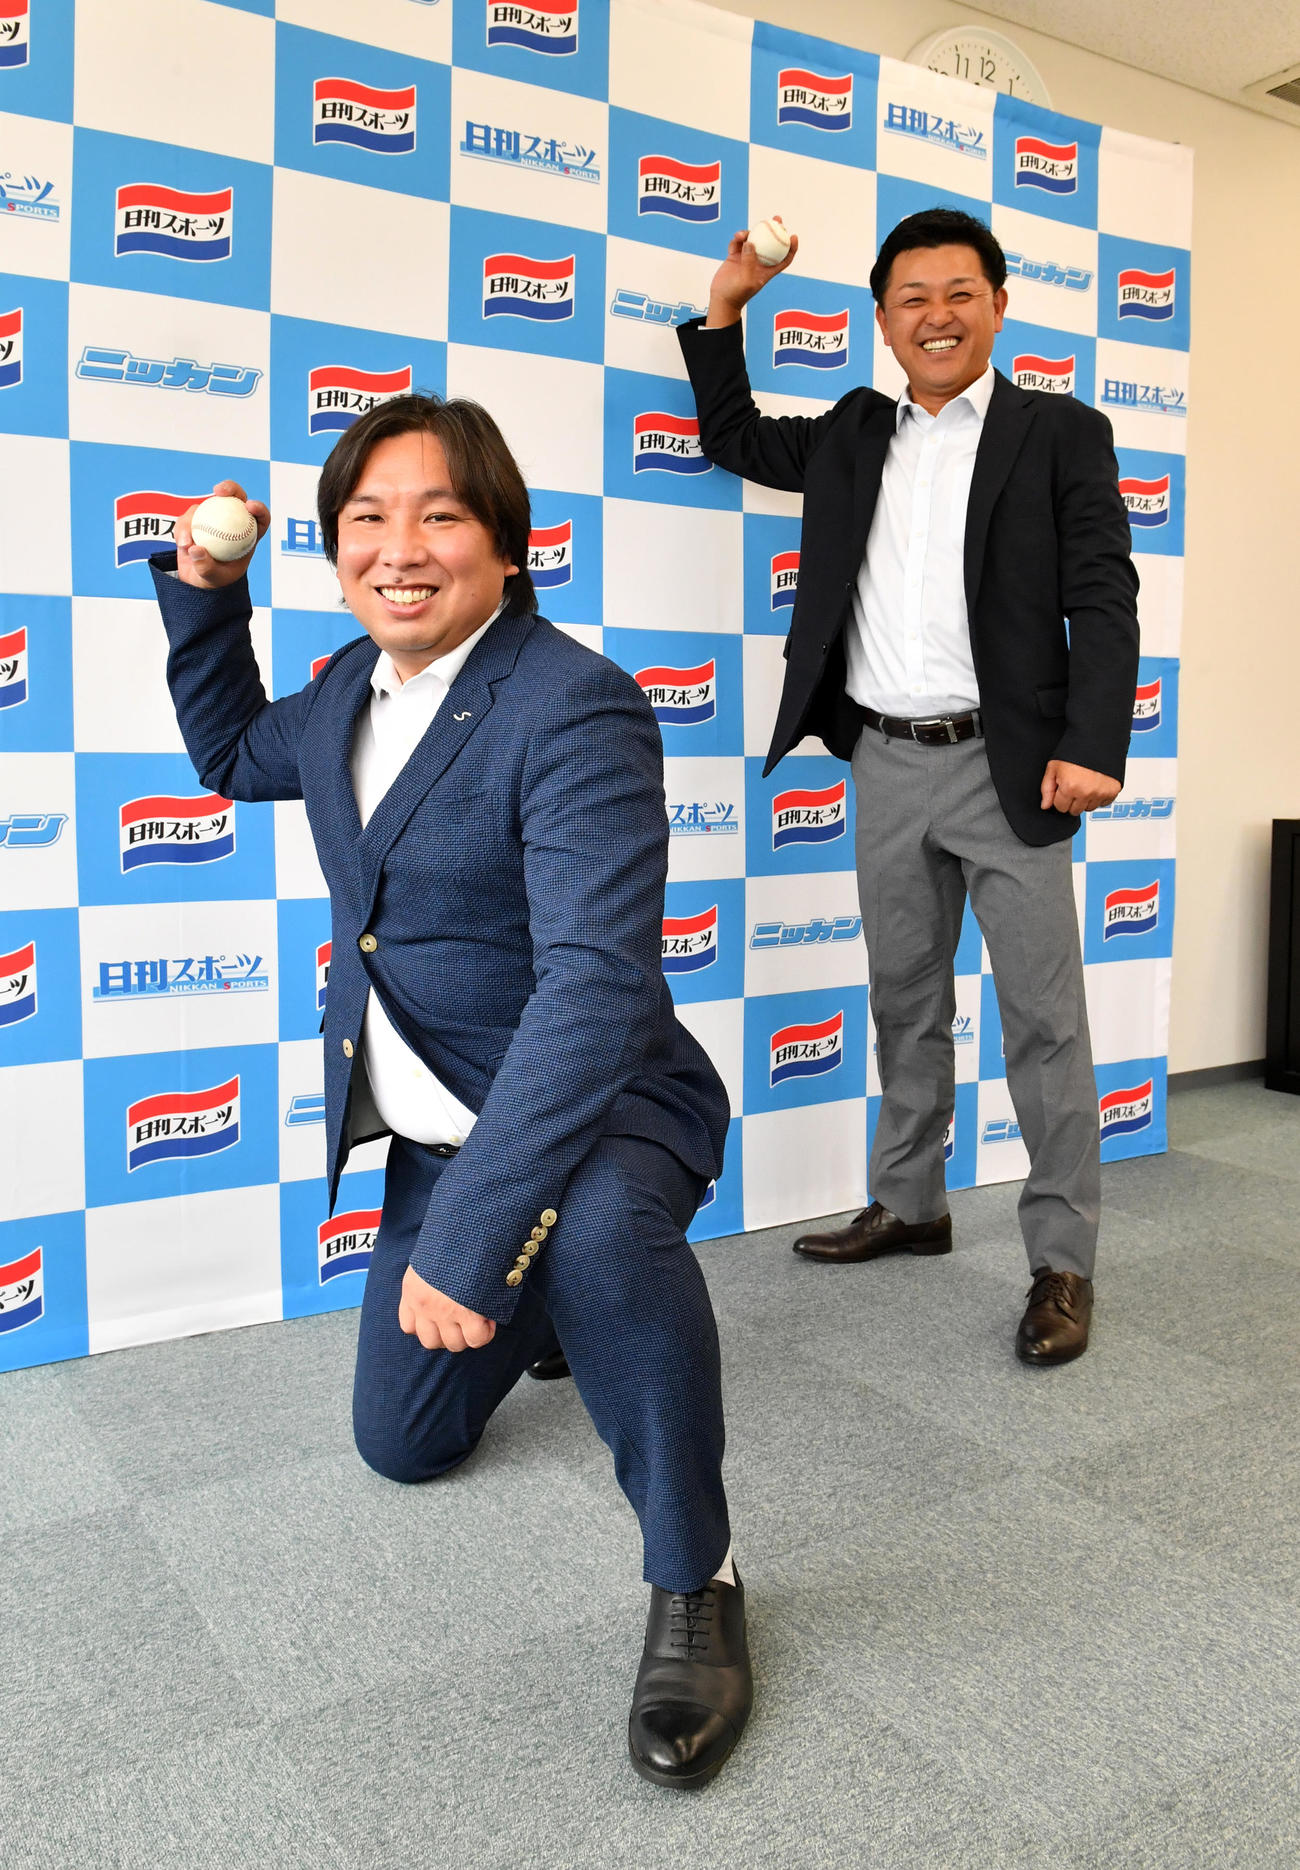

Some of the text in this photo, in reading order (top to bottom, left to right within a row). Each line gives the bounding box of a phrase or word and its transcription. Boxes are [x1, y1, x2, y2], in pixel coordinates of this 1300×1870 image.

[493, 6, 572, 34] 日刊スポーツ
[955, 53, 969, 79] 11
[980, 56, 996, 83] 12
[782, 89, 847, 112] 日刊スポーツ
[321, 102, 411, 131] 日刊スポーツ
[888, 102, 983, 146] 日刊スポーツ
[466, 120, 596, 168] 日刊スポーツ
[1020, 155, 1074, 178] 日刊スポーツ
[645, 177, 715, 202] 日刊スポーツ
[7, 202, 58, 217] SPORTS
[124, 209, 225, 237] 日刊スポーツ
[1004, 249, 1093, 292] ニッカン
[490, 276, 569, 300] 日刊スポーツ
[1122, 286, 1172, 305] 日刊スポーツ
[779, 331, 844, 351] 日刊スポーツ
[76, 347, 263, 398] ニッカン
[1017, 373, 1071, 392] 日刊スポーツ
[1104, 378, 1184, 406] 日刊スポーツ
[778, 804, 841, 828] 日刊スポーツ
[129, 815, 227, 845] 日刊スポーツ
[1108, 901, 1156, 922] 日刊スポーツ
[750, 917, 862, 949] ニッカン
[99, 953, 263, 996] 日刊スポーツ
[168, 979, 268, 994] NIKKAN SPORTS
[775, 1034, 838, 1063] 日刊スポーツ
[136, 1105, 233, 1144] 日刊スポーツ
[1102, 1098, 1149, 1125] 日刊スポーツ
